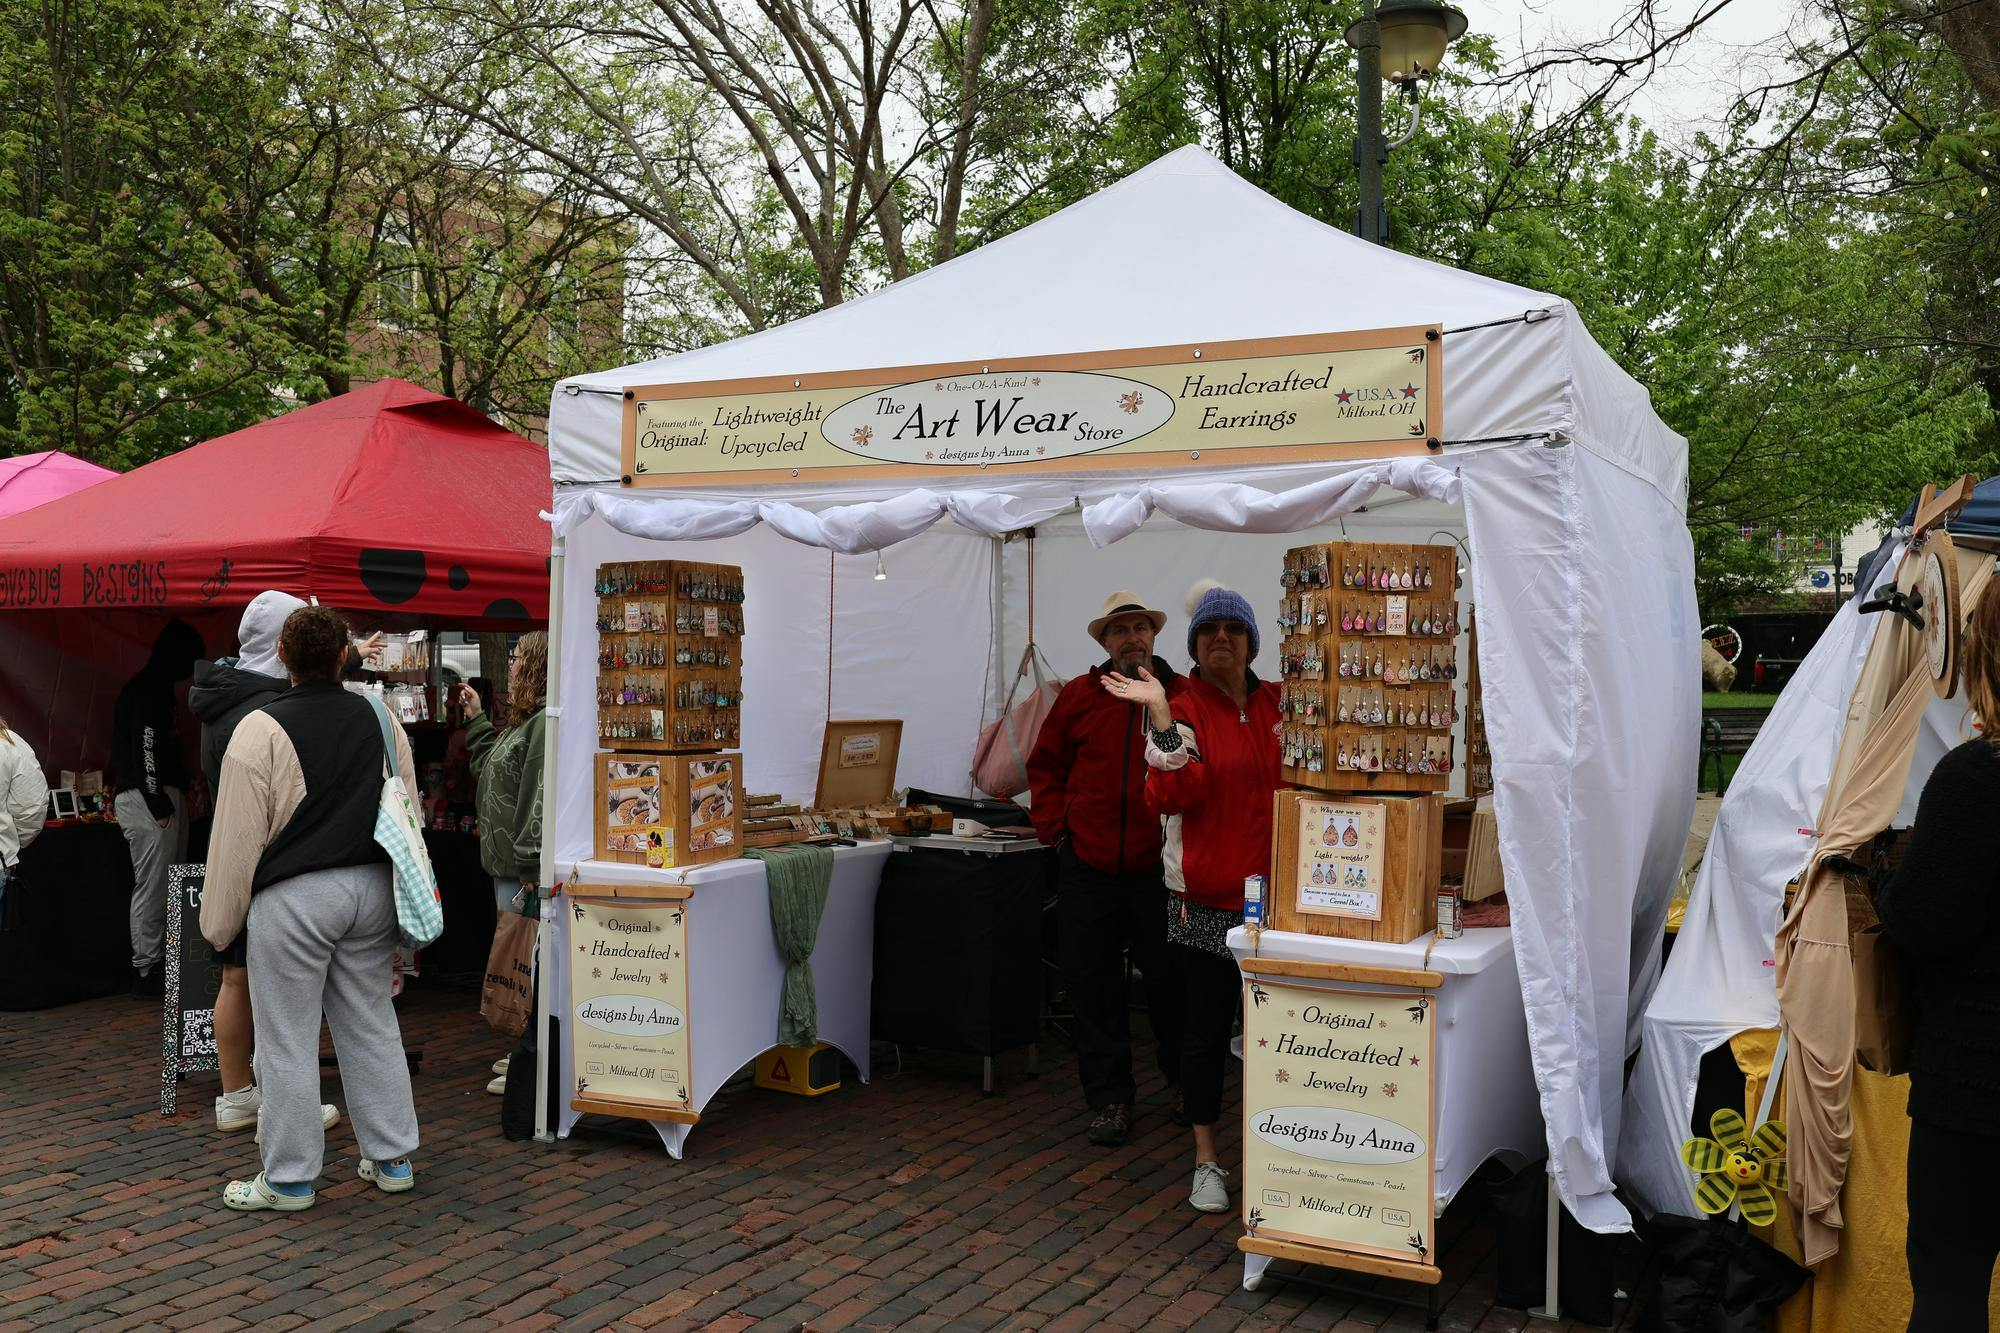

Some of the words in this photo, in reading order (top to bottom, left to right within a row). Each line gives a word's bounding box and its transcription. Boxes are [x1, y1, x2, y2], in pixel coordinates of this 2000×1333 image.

[946, 377, 1027, 392] One-Of-A-Kind
[1179, 366, 1334, 399] Handcrafted
[712, 402, 822, 430] Lightweight
[1198, 406, 1298, 431] Earrings
[1389, 401, 1417, 416] OH
[647, 418, 687, 430] Featuring
[689, 416, 704, 427] the
[875, 397, 905, 415] The
[893, 403, 960, 440] Art
[974, 397, 1079, 438] Wear
[1073, 422, 1124, 442] Store
[720, 431, 808, 458] Upcycled
[939, 446, 980, 461] designs
[980, 446, 996, 460] by
[997, 446, 1030, 457] Anna
[1320, 806, 1333, 814] Why
[1314, 850, 1333, 860] Light
[608, 918, 652, 934] Original
[591, 940, 671, 960] Handcrafted
[610, 967, 652, 985] Jewelry
[582, 1003, 627, 1024] designs
[629, 1006, 645, 1026] by
[646, 1007, 679, 1025] Anna
[1303, 1005, 1374, 1030] Original
[1275, 1033, 1403, 1067] Handcrafted
[639, 1067, 655, 1079] OH
[1304, 1071, 1368, 1098] Jewelry
[1258, 1114, 1329, 1142] designs
[1330, 1123, 1356, 1149] by
[1359, 1127, 1416, 1153] Anna
[1267, 1163, 1302, 1177] Upcycled
[1307, 1169, 1328, 1180] Silver
[1336, 1174, 1375, 1187] Gemstones
[1383, 1180, 1406, 1191] Pearls
[1347, 1203, 1373, 1219] OH
